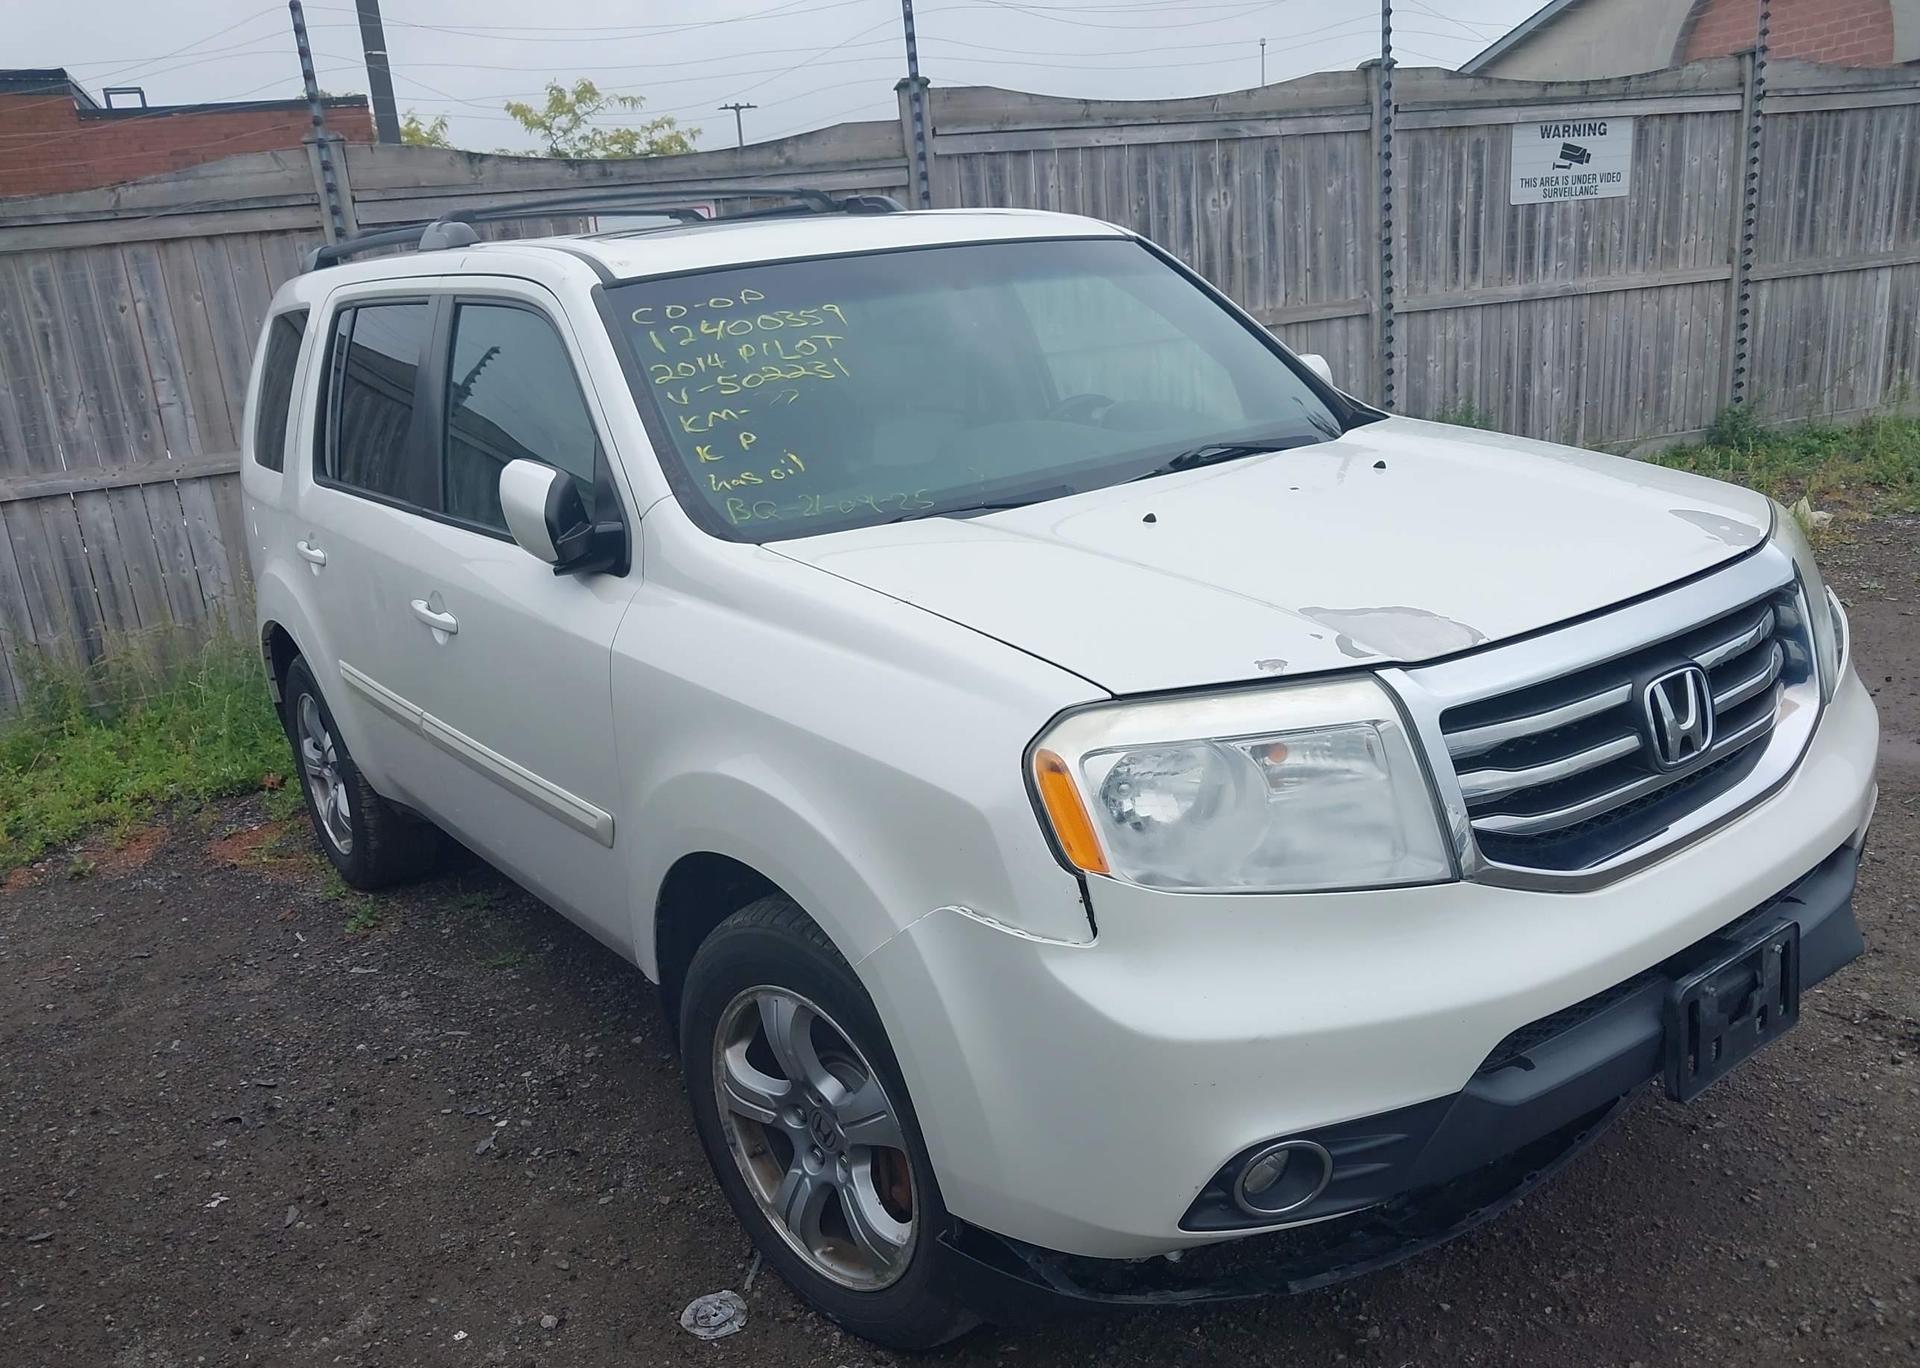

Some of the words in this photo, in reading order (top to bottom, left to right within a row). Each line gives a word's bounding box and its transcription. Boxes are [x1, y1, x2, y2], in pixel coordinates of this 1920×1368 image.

[1540, 122, 1607, 139] WARNING
[1520, 177, 1538, 188] THIS
[1540, 176, 1559, 187] AREA
[1561, 175, 1570, 186] IS
[1571, 173, 1597, 185] UNDER
[1600, 171, 1622, 183] VIDEO
[1542, 185, 1599, 199] SURVEILLANCE
[650, 352, 727, 384] 2014
[738, 335, 844, 363] PILOT
[708, 471, 764, 492] has
[769, 449, 806, 480] oil
